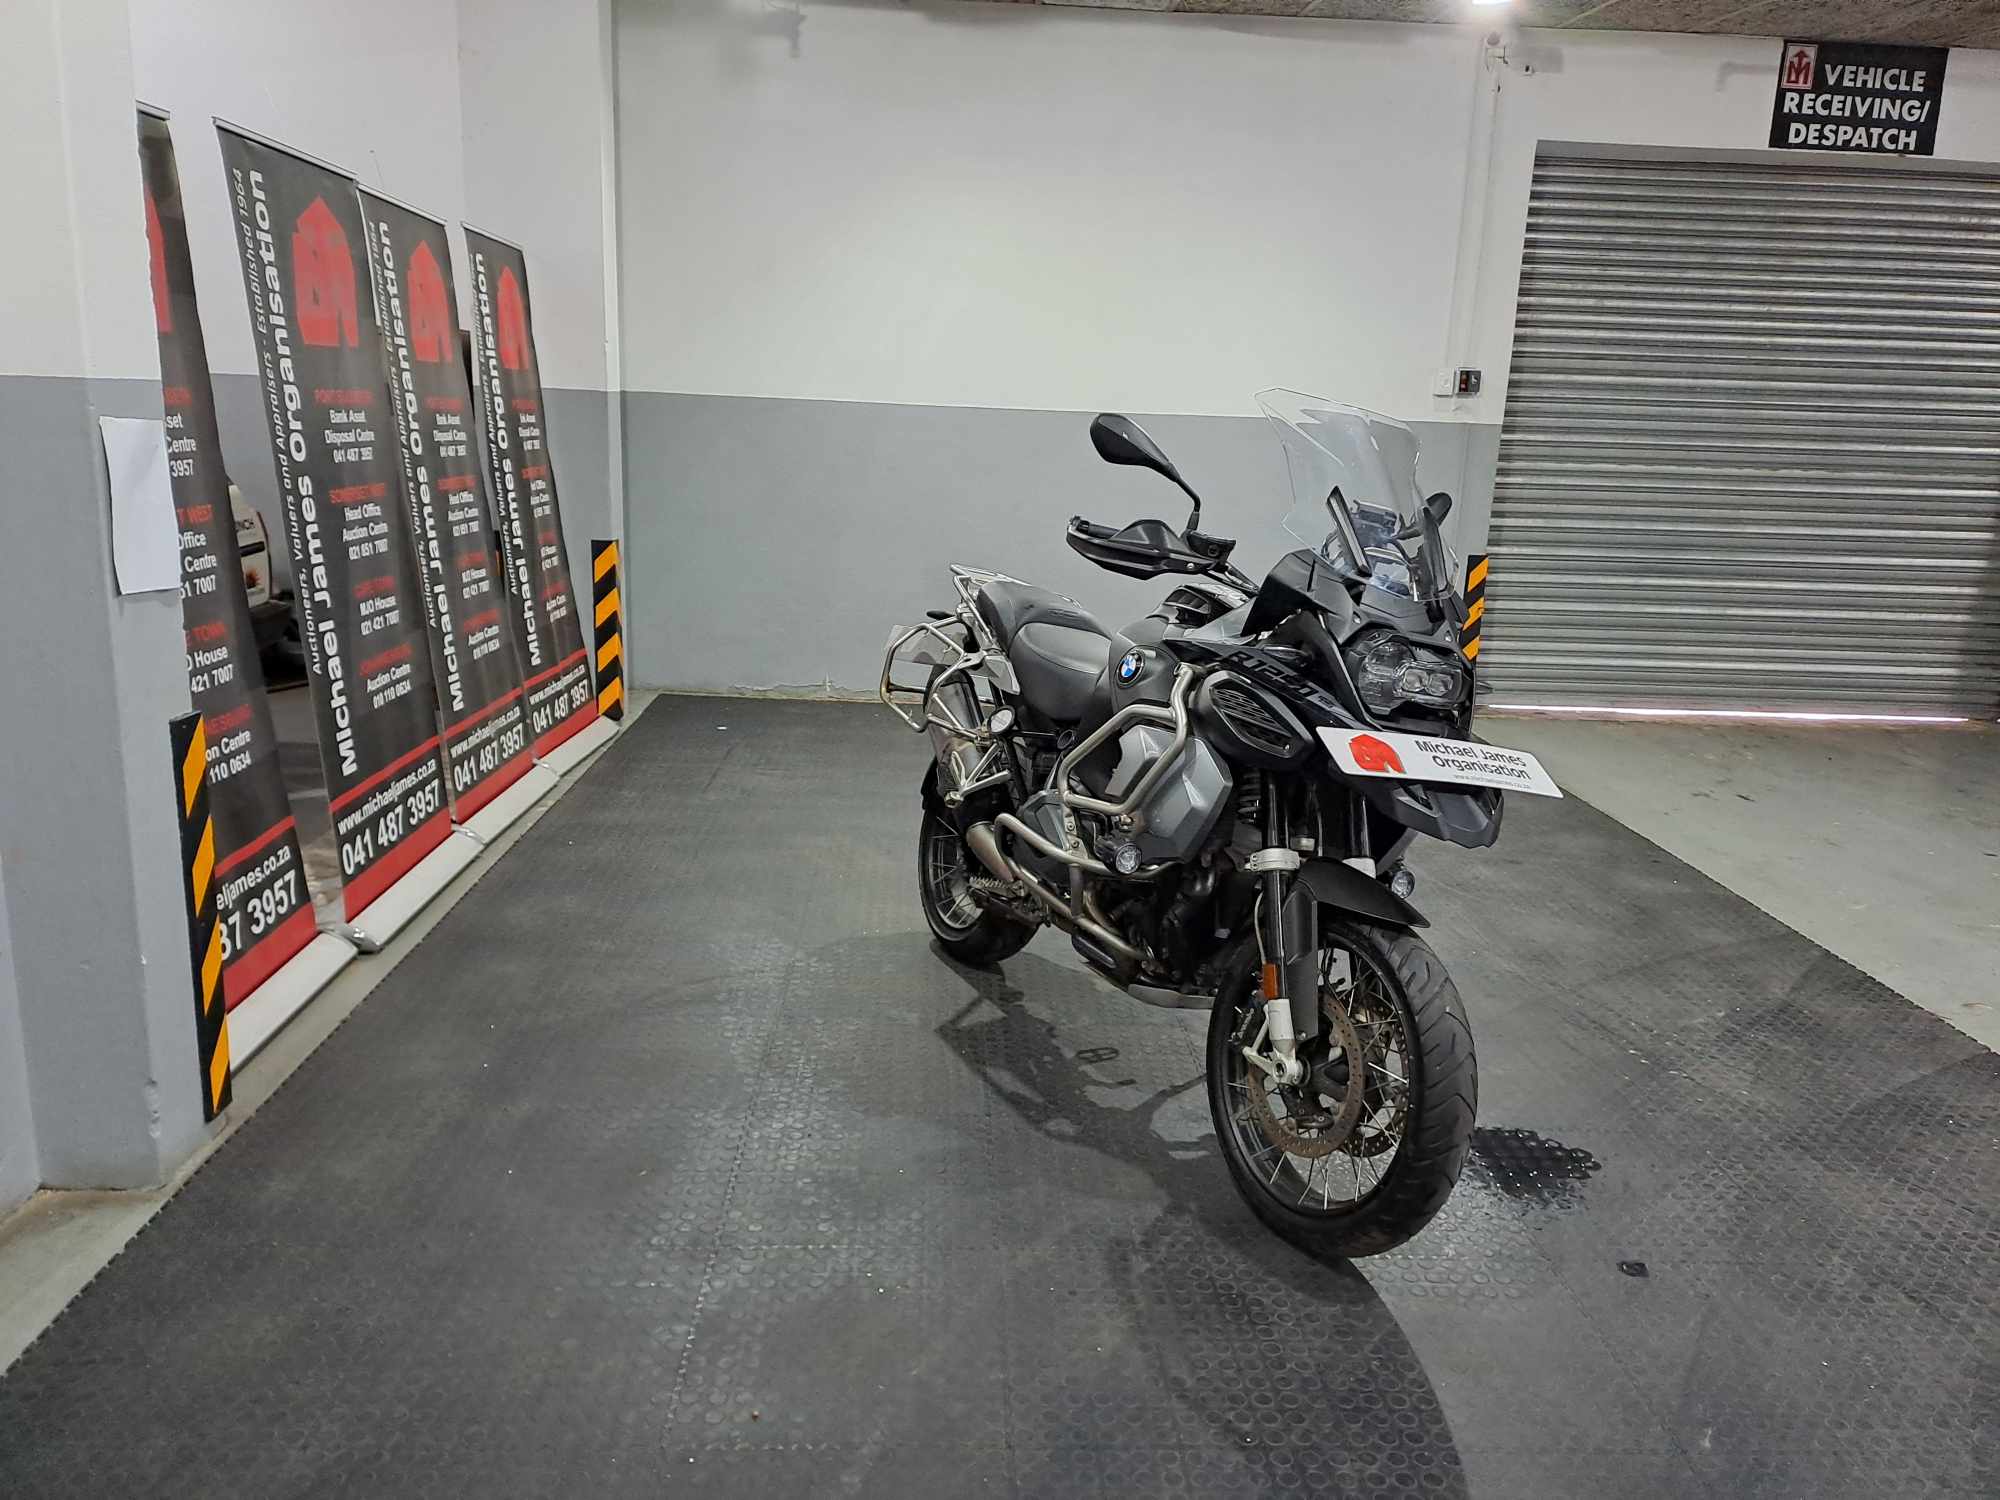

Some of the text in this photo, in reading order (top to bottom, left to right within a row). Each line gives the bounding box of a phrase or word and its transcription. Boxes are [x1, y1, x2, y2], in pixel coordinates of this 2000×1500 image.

[1783, 91, 1931, 123] RECEIVING/
[1824, 63, 1927, 93] VEHICLE
[1787, 122, 1918, 151] DESPATCH
[232, 167, 249, 218] 1964
[240, 221, 267, 334] Established
[263, 351, 286, 450] Appraisers
[278, 454, 292, 489] and
[502, 458, 524, 550] James
[287, 495, 303, 561] Valuers
[297, 475, 331, 609] James
[417, 466, 443, 574] James
[184, 553, 217, 573] Centre
[193, 574, 217, 595] 7007
[299, 568, 322, 675] Auctioneers,
[515, 558, 541, 666] Michael
[191, 663, 234, 694] 421 7007
[193, 646, 228, 669] House
[433, 584, 464, 712] Michael
[318, 619, 358, 777] Michael
[532, 678, 589, 733] 041 487 3957
[453, 722, 524, 792] 041 487 3957
[1414, 739, 1527, 767] Michael James
[1431, 755, 1532, 780] Organisation
[337, 758, 437, 835] www.michaeljames.co.za
[342, 778, 439, 875] 041 487 3957
[247, 868, 297, 935] 3957
